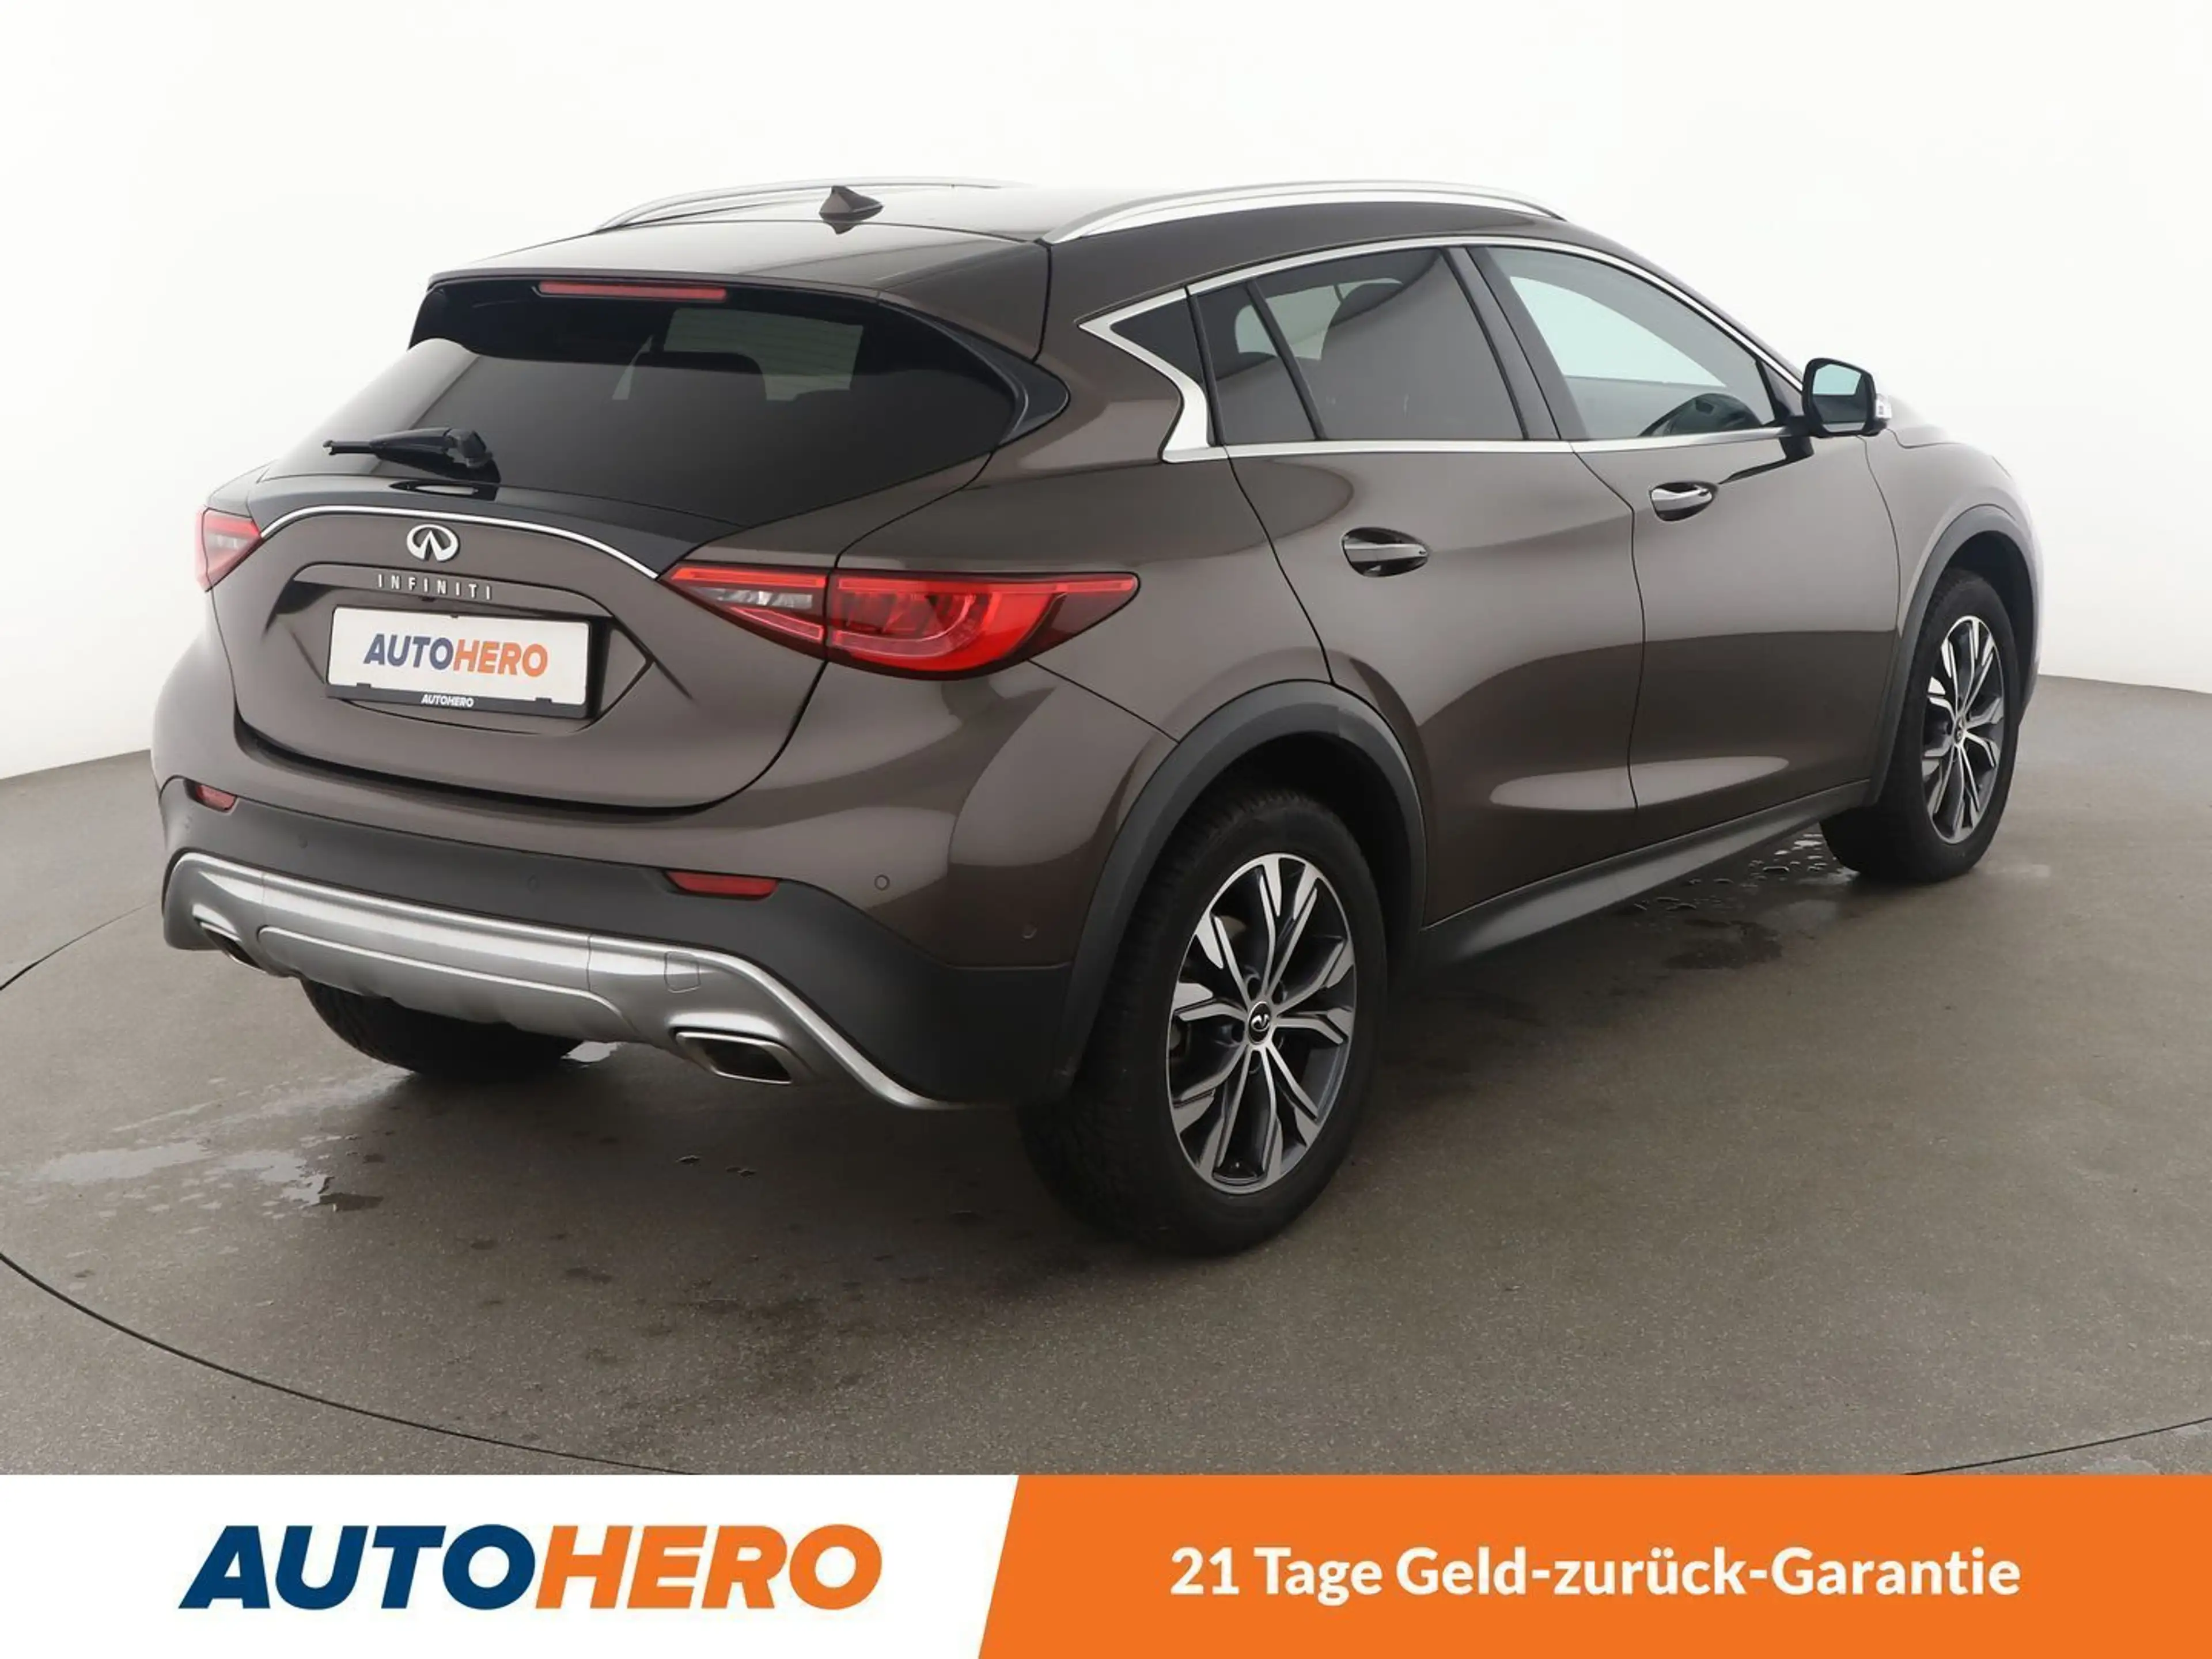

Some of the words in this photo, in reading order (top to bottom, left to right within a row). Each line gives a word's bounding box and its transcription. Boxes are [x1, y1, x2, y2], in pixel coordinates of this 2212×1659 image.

[378, 573, 491, 600] INFINITI
[363, 632, 548, 679] AUTOHERO
[421, 694, 475, 707] AUTOHERO
